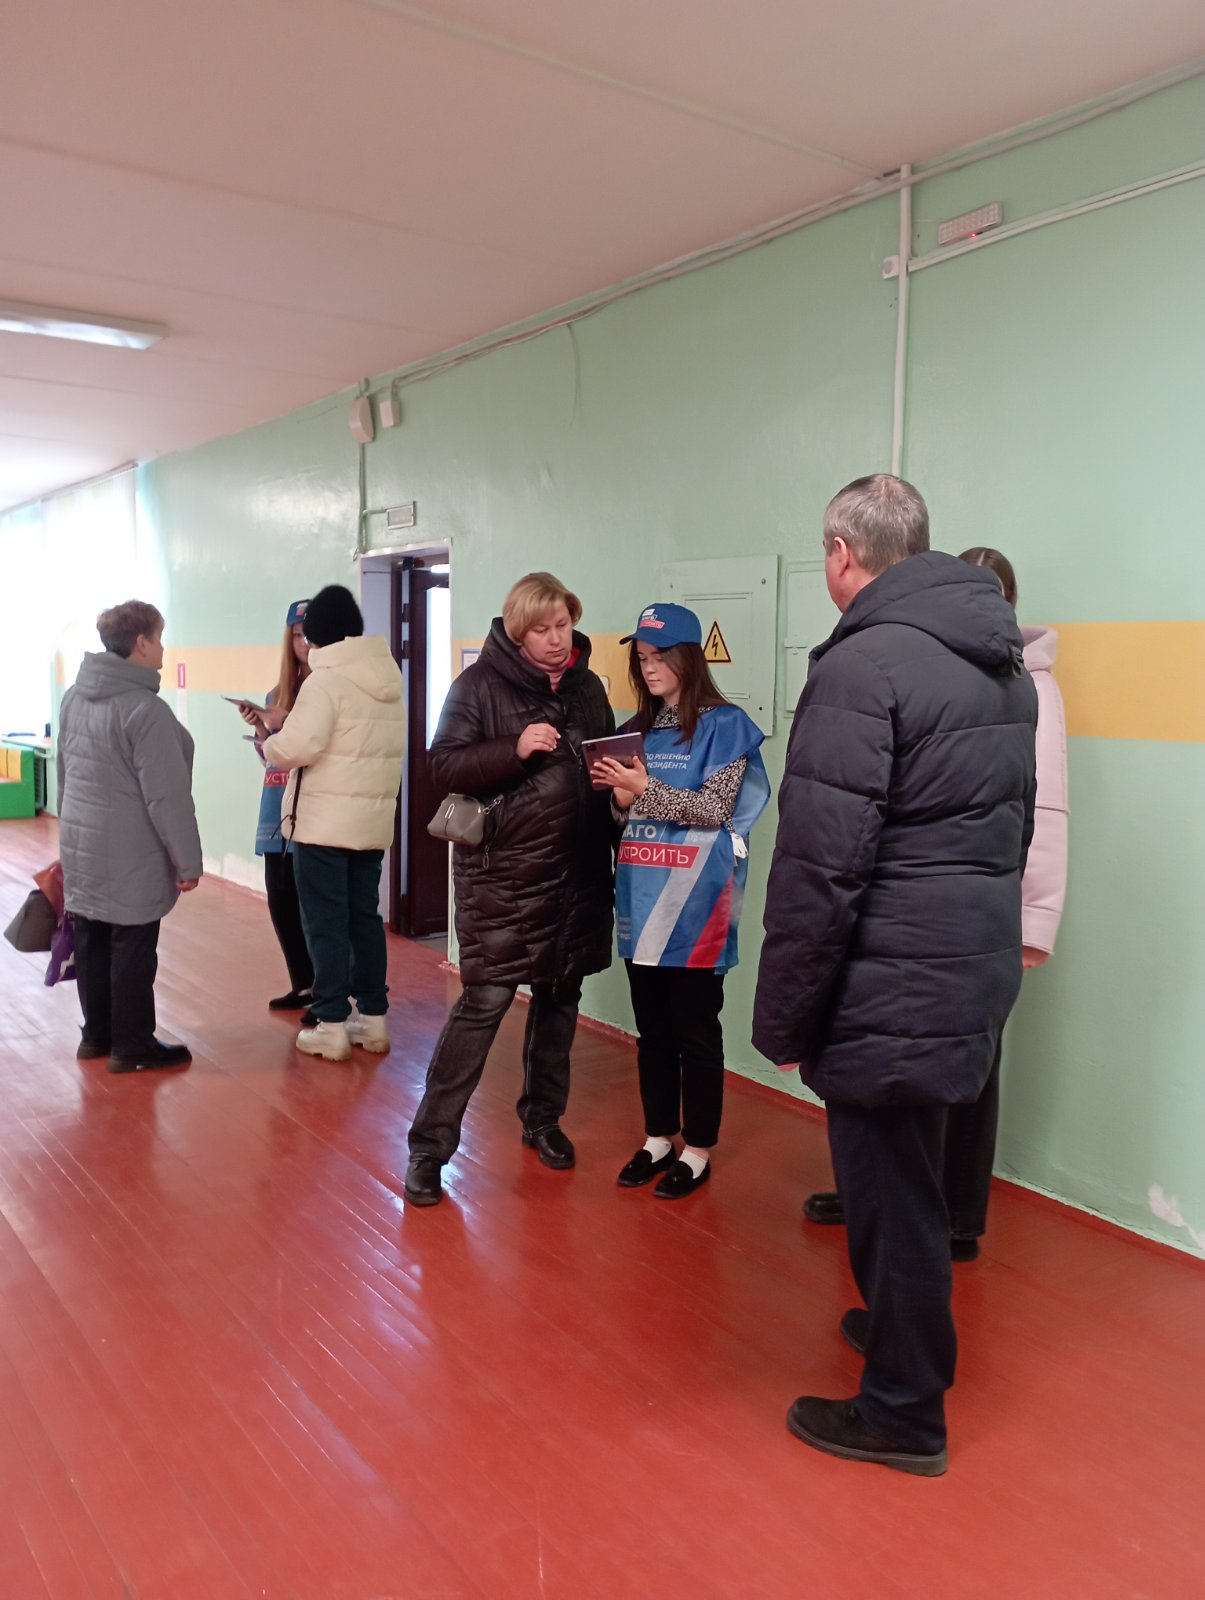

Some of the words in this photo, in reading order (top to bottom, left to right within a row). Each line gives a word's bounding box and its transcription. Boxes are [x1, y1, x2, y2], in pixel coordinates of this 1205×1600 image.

[654, 753, 691, 761] РЕШЕНИЮ
[646, 761, 687, 769] РЕЗИДЕНТА
[622, 825, 656, 839] АГО
